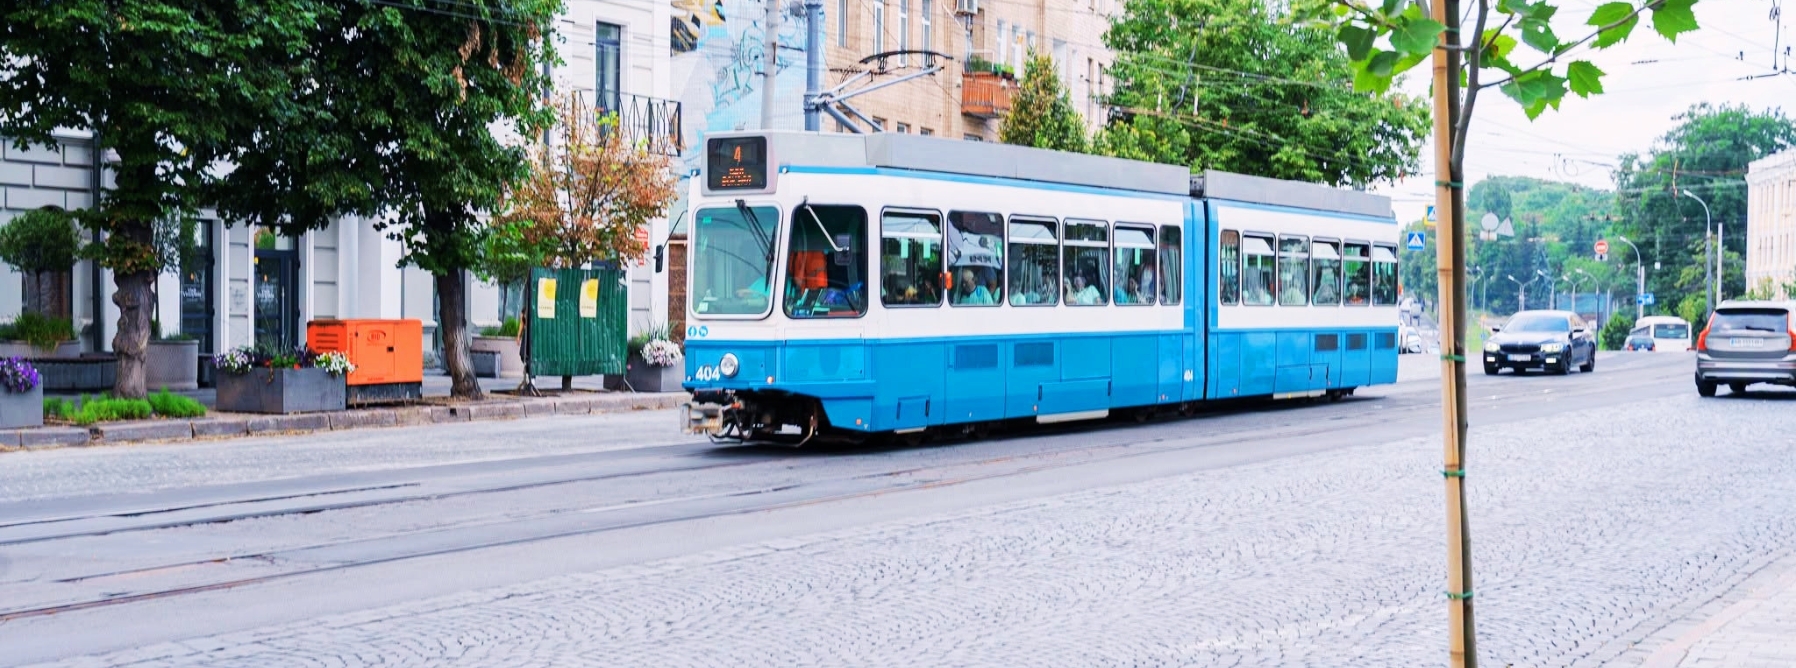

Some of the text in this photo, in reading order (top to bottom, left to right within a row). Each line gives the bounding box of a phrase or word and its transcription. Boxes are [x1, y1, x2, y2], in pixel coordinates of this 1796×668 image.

[734, 146, 741, 162] 4
[695, 366, 721, 381] 404
[1184, 369, 1194, 381] 404
